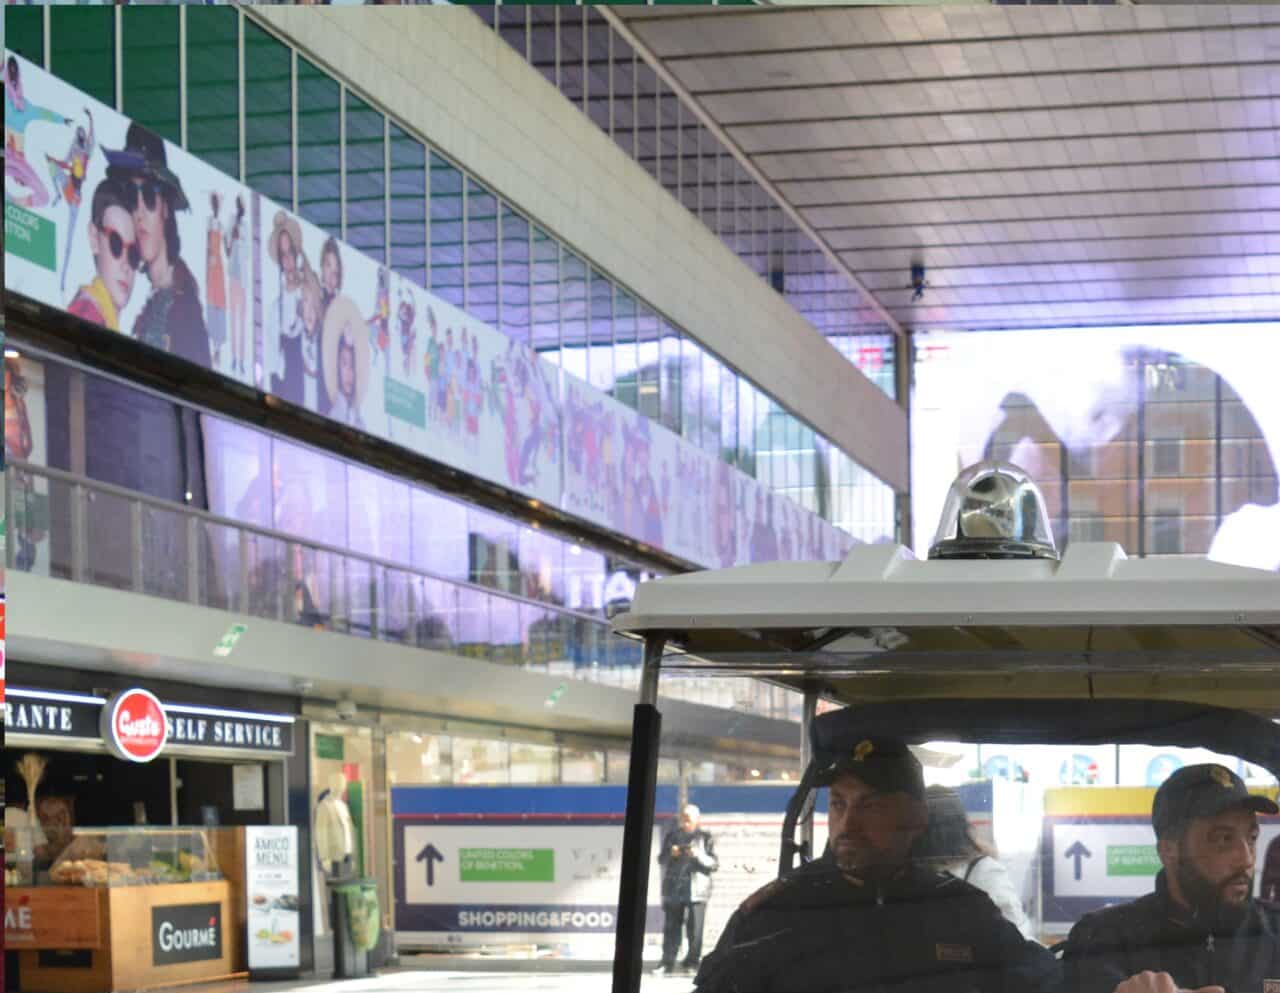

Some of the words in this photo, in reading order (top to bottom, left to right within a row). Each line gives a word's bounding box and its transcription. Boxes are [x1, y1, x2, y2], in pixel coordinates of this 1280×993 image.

[167, 717, 207, 741] SELF
[214, 720, 282, 747] SERVICE
[458, 911, 613, 928] SHOPPING&FOOD
